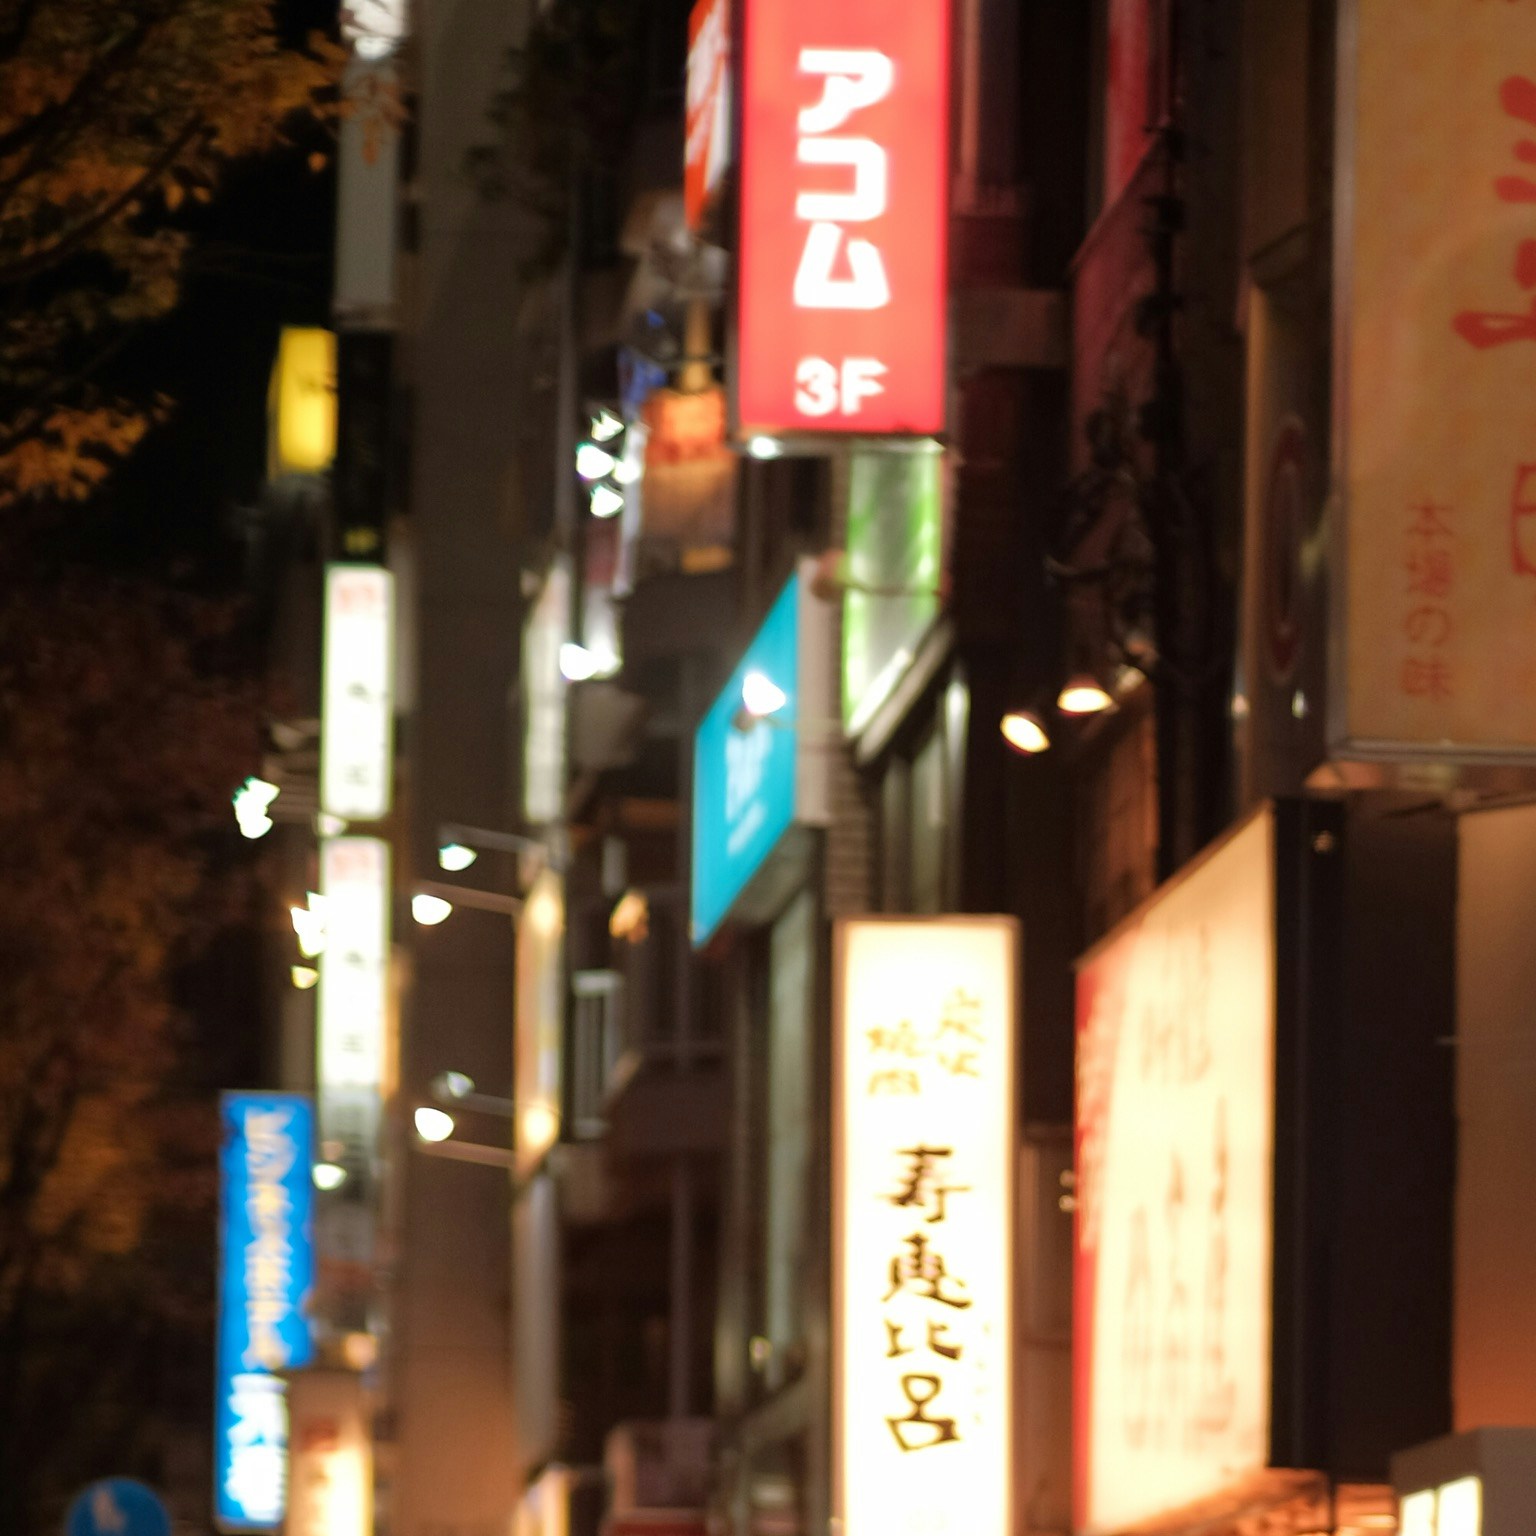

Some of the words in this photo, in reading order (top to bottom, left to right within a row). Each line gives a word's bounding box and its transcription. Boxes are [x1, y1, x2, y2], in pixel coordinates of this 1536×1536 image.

[792, 48, 893, 310] アコム
[793, 356, 889, 417] 3F
[1401, 496, 1457, 701] 本場の味
